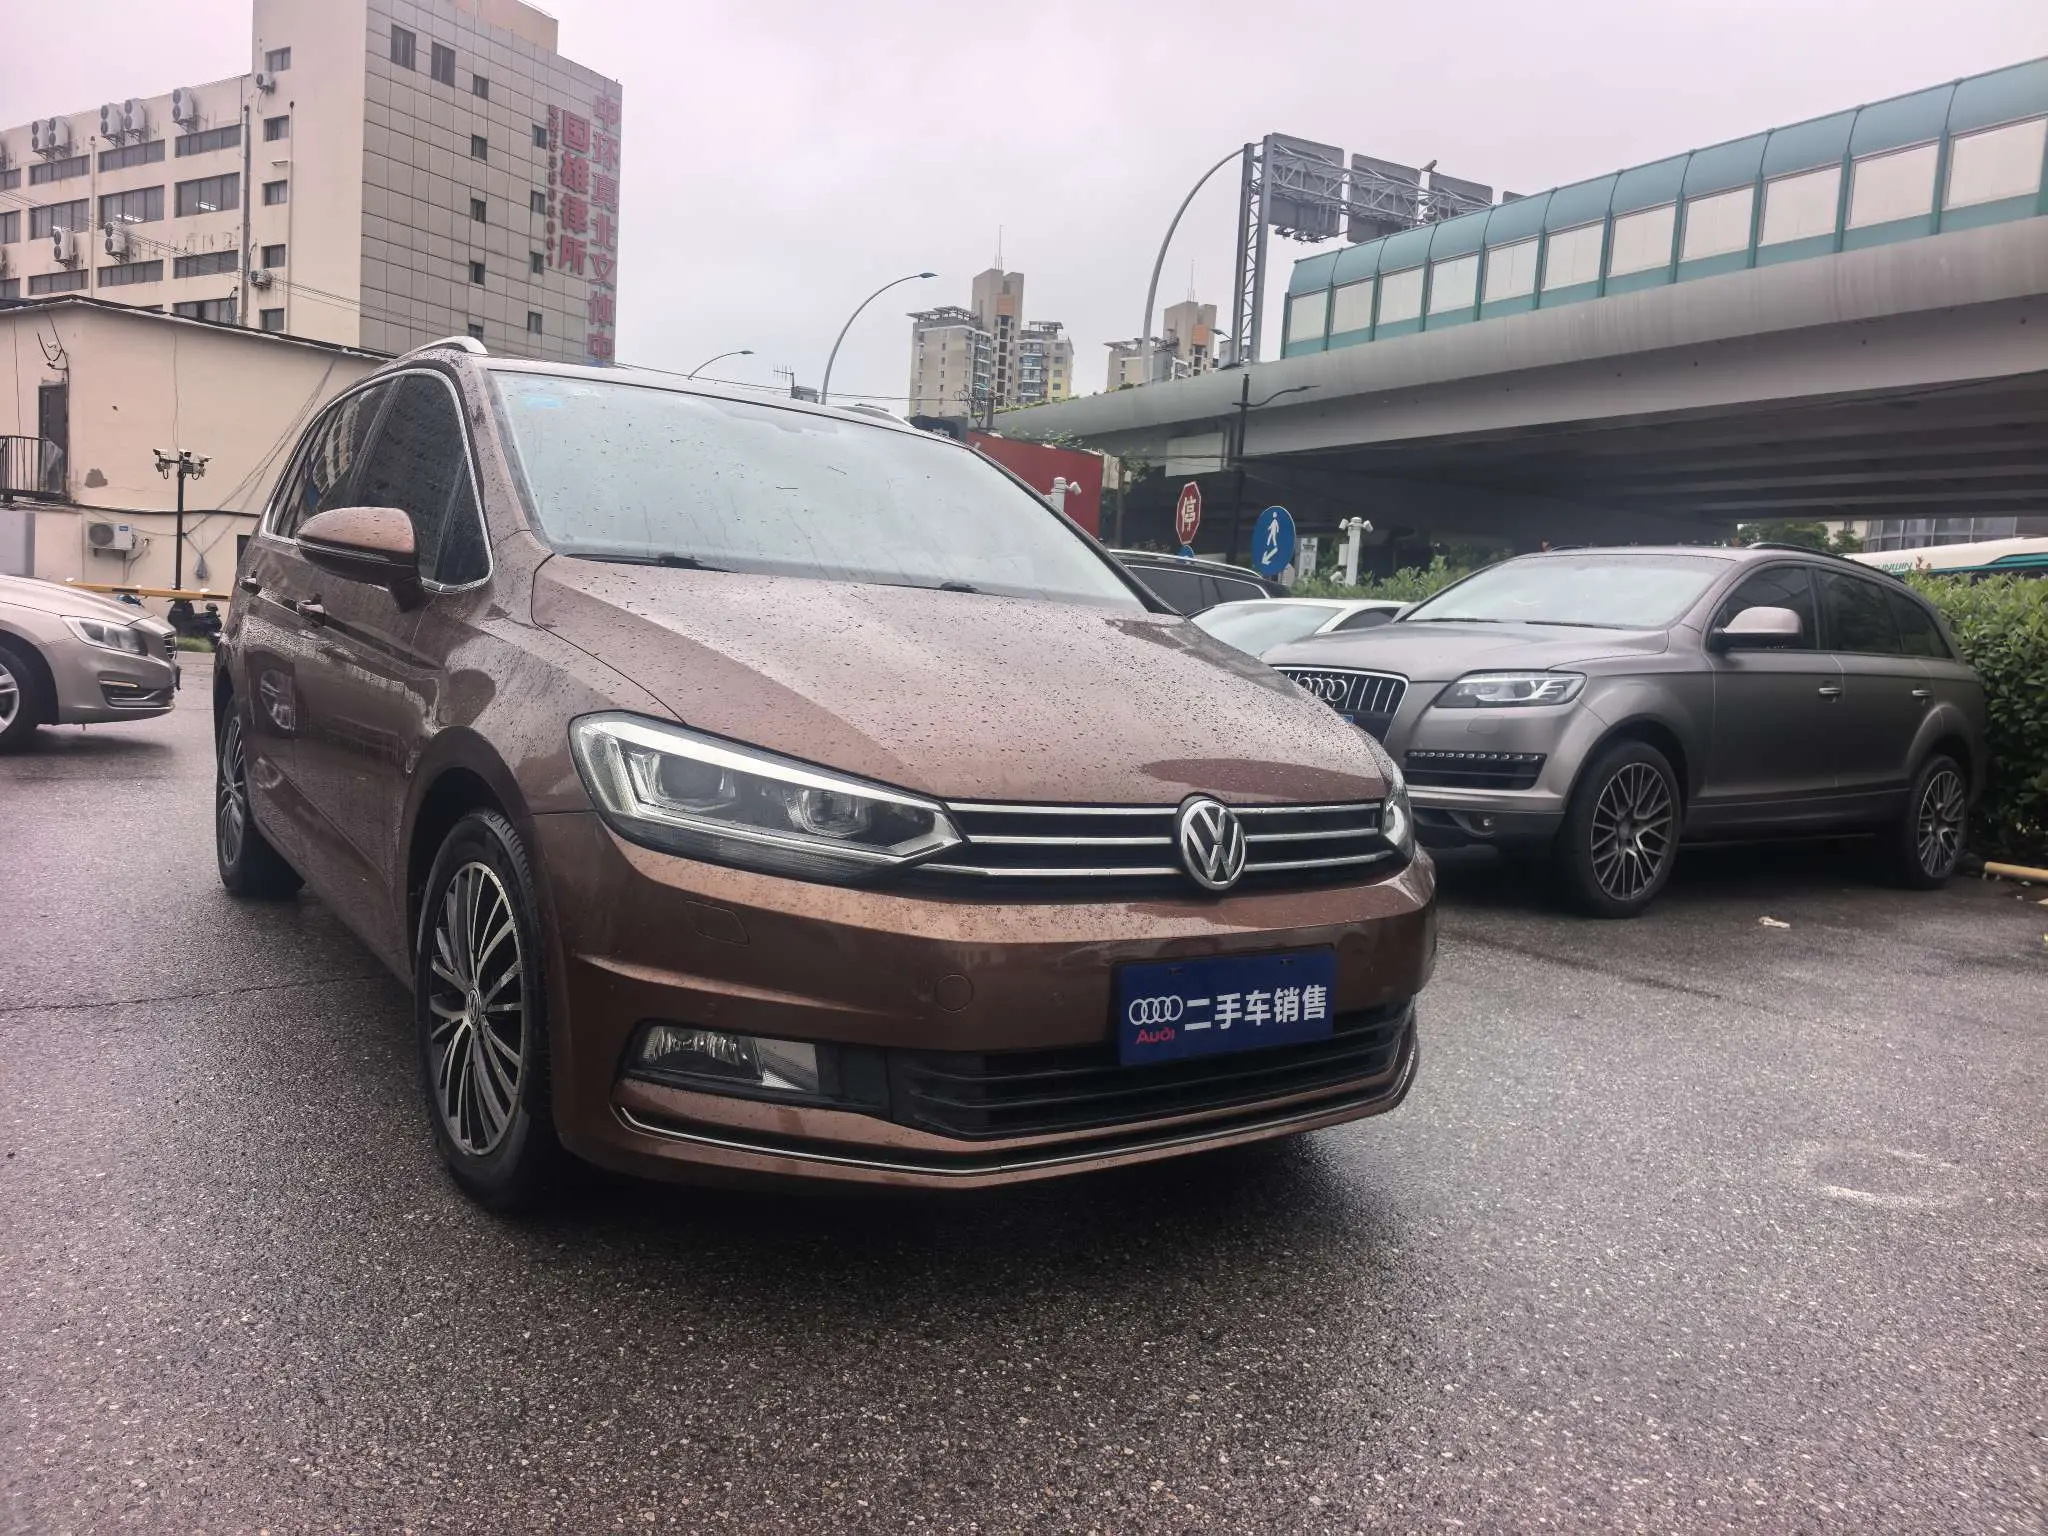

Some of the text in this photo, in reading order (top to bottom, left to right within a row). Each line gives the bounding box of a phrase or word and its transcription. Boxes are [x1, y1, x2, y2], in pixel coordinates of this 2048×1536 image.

[558, 109, 590, 277] 国雄律所
[1181, 495, 1196, 532] 停
[1184, 984, 1327, 1031] 二手车销售
[1135, 1027, 1176, 1045] Audi
